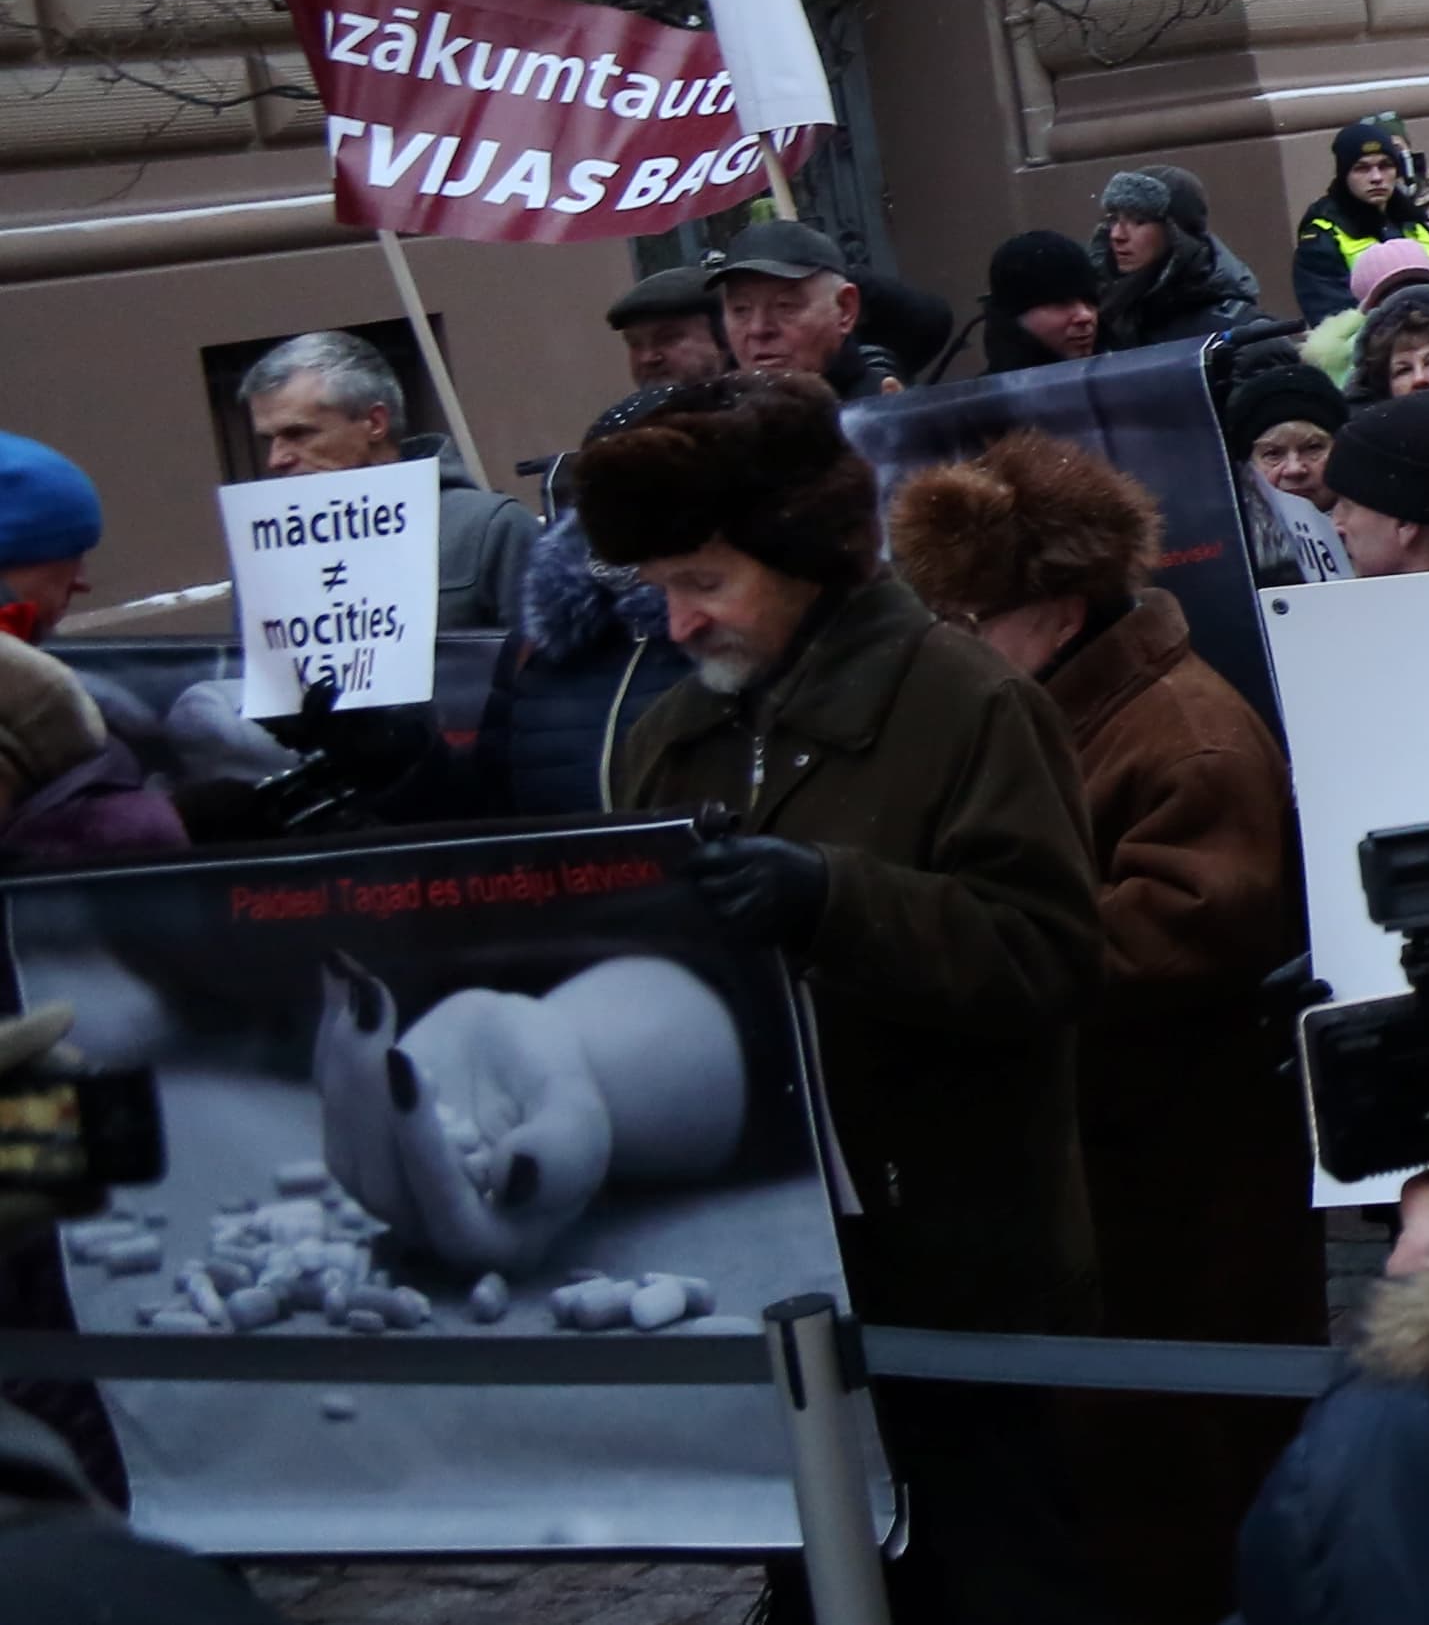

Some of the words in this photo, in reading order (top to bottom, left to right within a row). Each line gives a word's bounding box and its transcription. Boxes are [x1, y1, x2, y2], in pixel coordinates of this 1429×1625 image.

[251, 494, 407, 551] mācīties
[261, 597, 406, 651] mocīties,
[338, 877, 421, 920] Tagad
[428, 878, 461, 907] es
